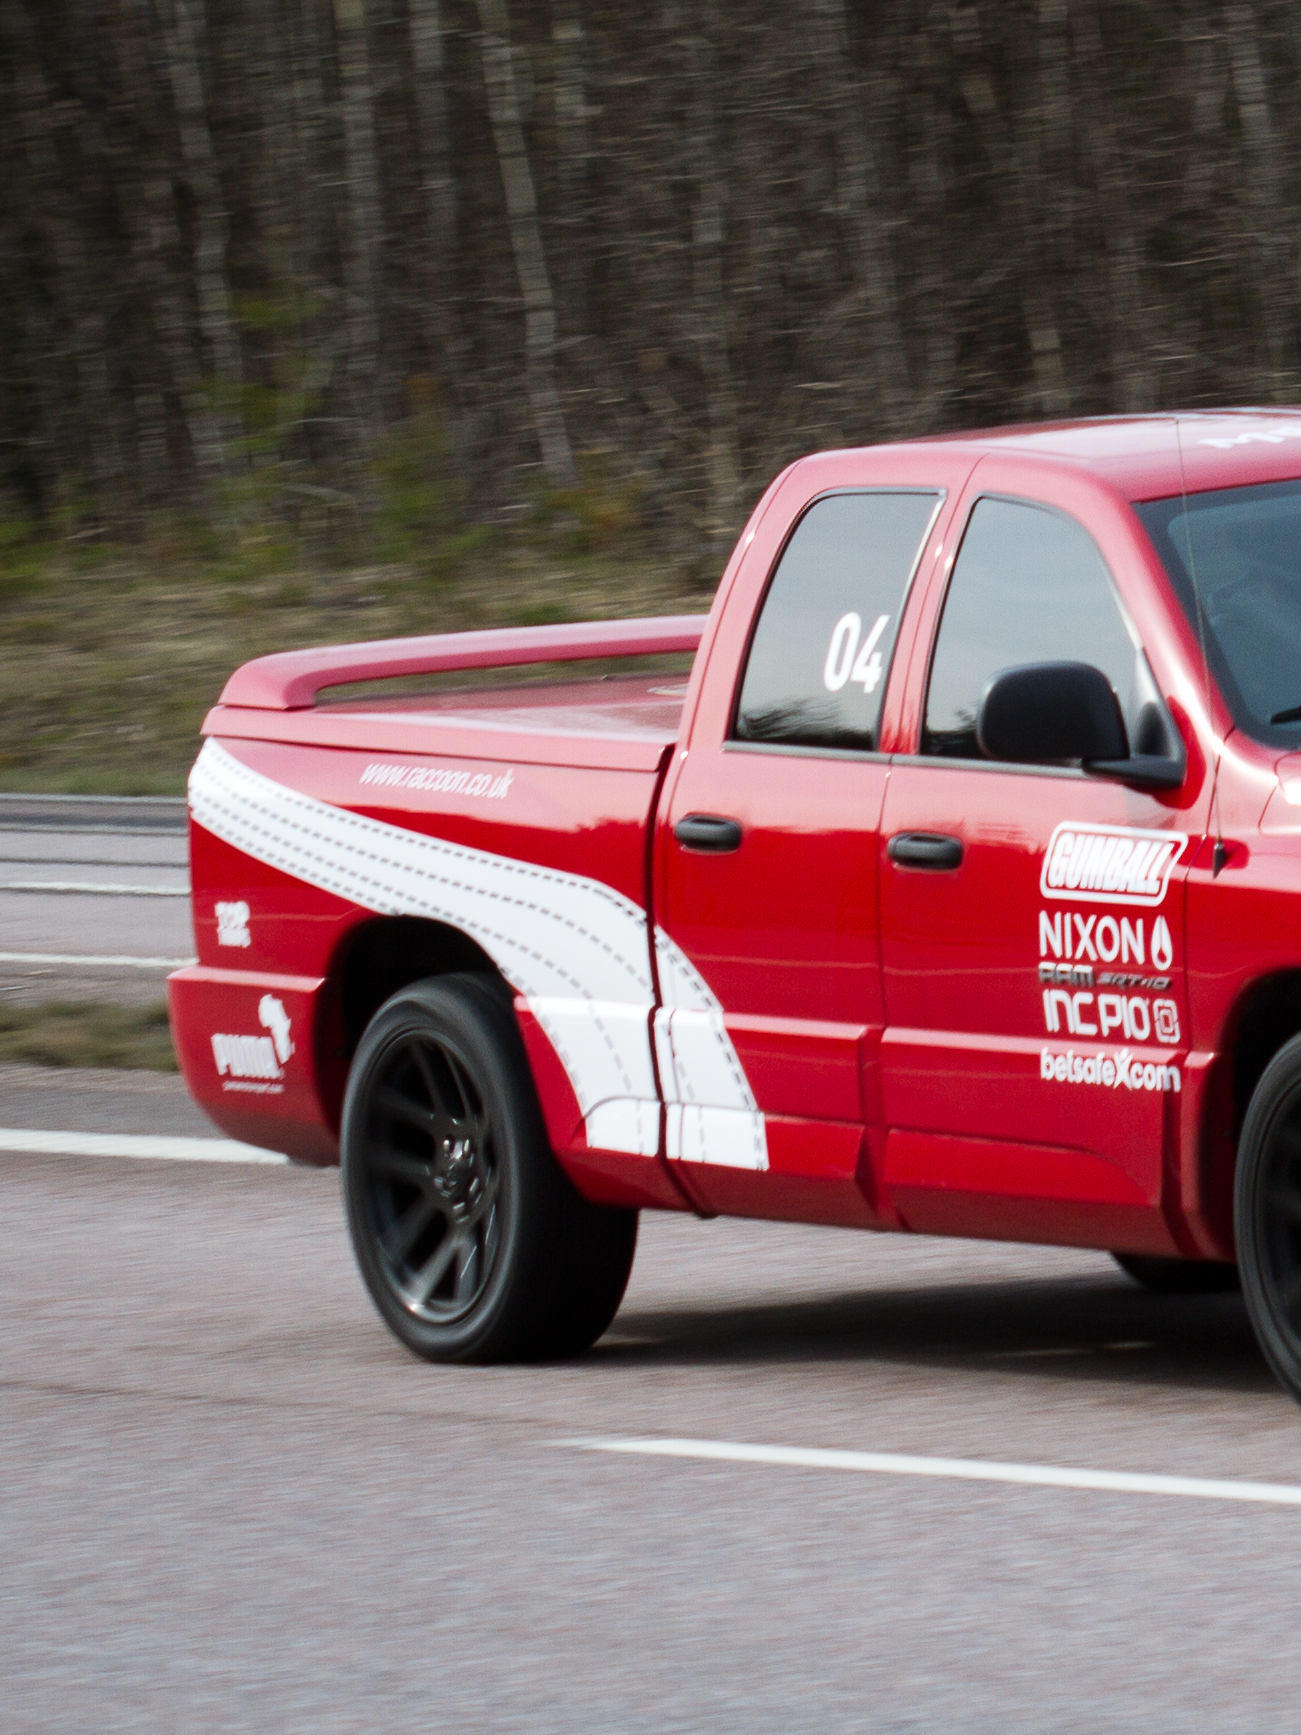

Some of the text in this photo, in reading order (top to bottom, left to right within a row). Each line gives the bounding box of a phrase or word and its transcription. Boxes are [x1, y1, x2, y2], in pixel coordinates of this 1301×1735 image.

[824, 612, 890, 693] 04
[1049, 832, 1175, 895] GUMBALL
[1038, 910, 1145, 965] NIXON
